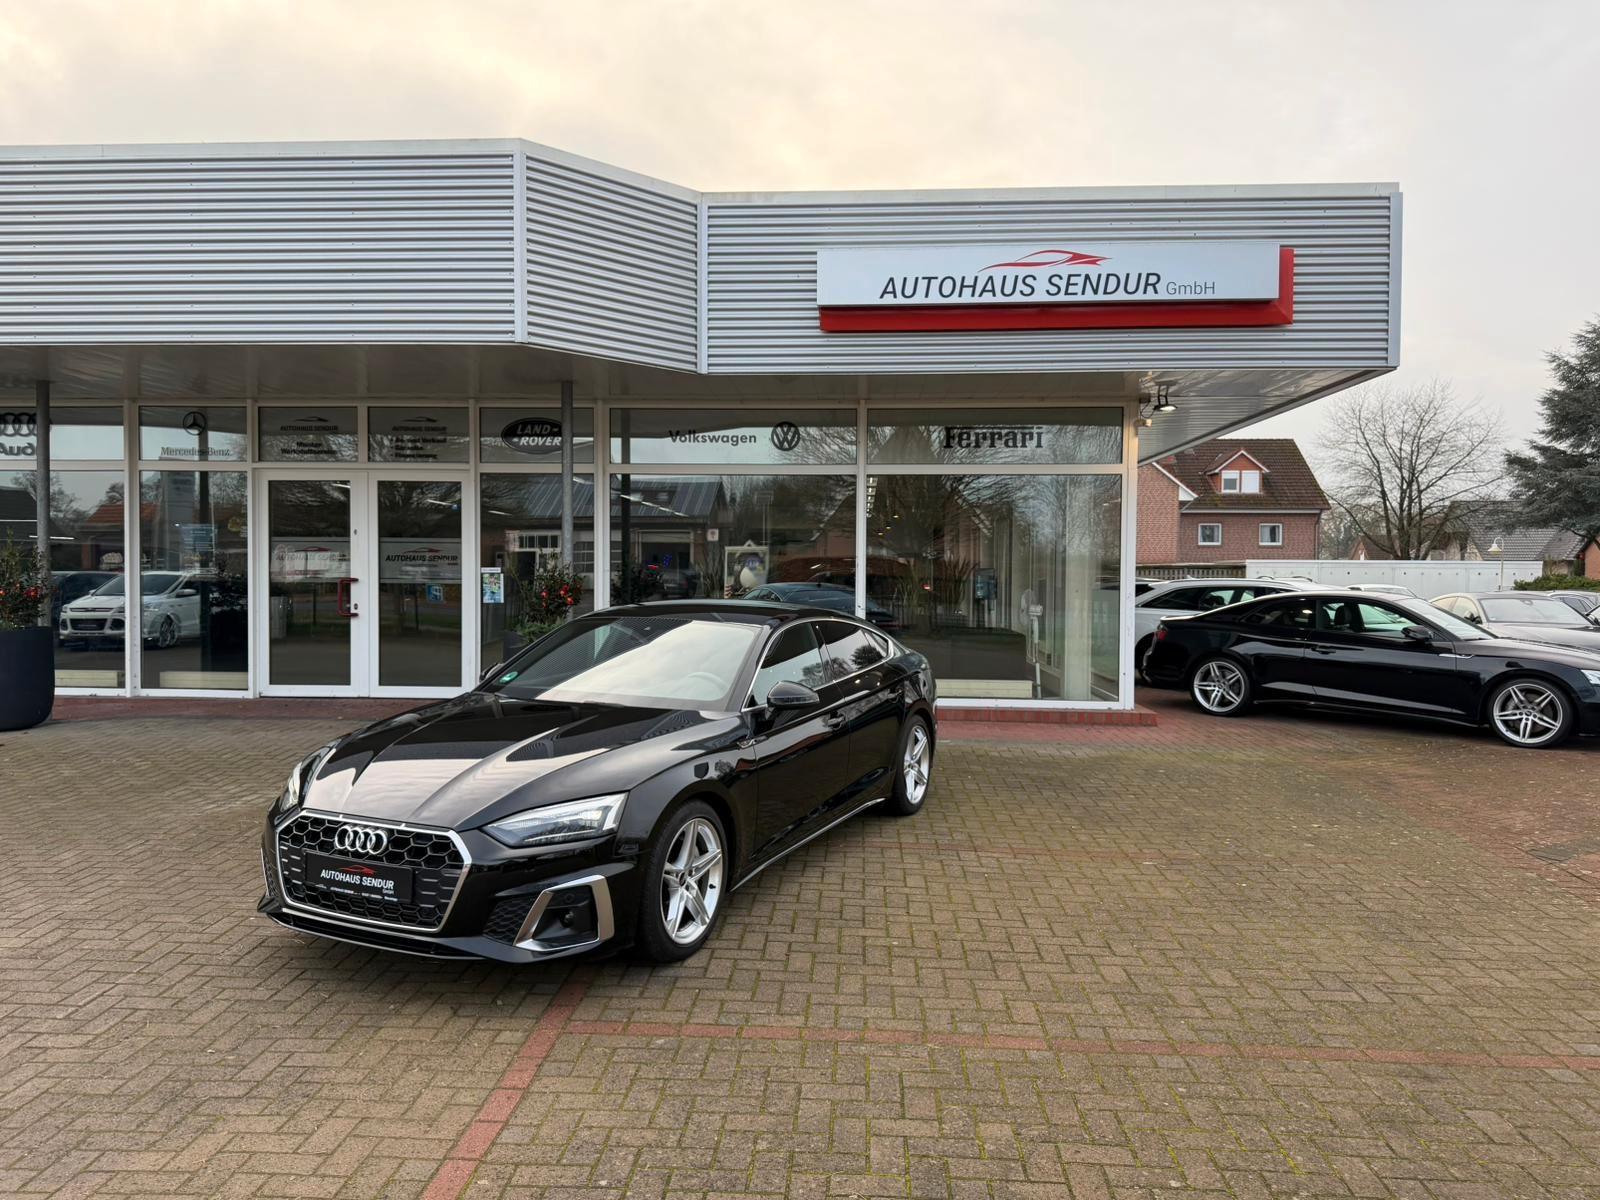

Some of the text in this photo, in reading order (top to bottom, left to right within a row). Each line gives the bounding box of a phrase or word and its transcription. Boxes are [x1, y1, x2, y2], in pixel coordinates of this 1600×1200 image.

[880, 272, 1216, 300] AUTOHAUS SENDUR GmbH
[520, 436, 562, 446] ROVER
[669, 430, 757, 447] Volkswagen
[943, 426, 1043, 449] Ferrari
[385, 554, 426, 562] AUTOHAUS
[320, 869, 394, 889] AUTOHAUS SENDUR
